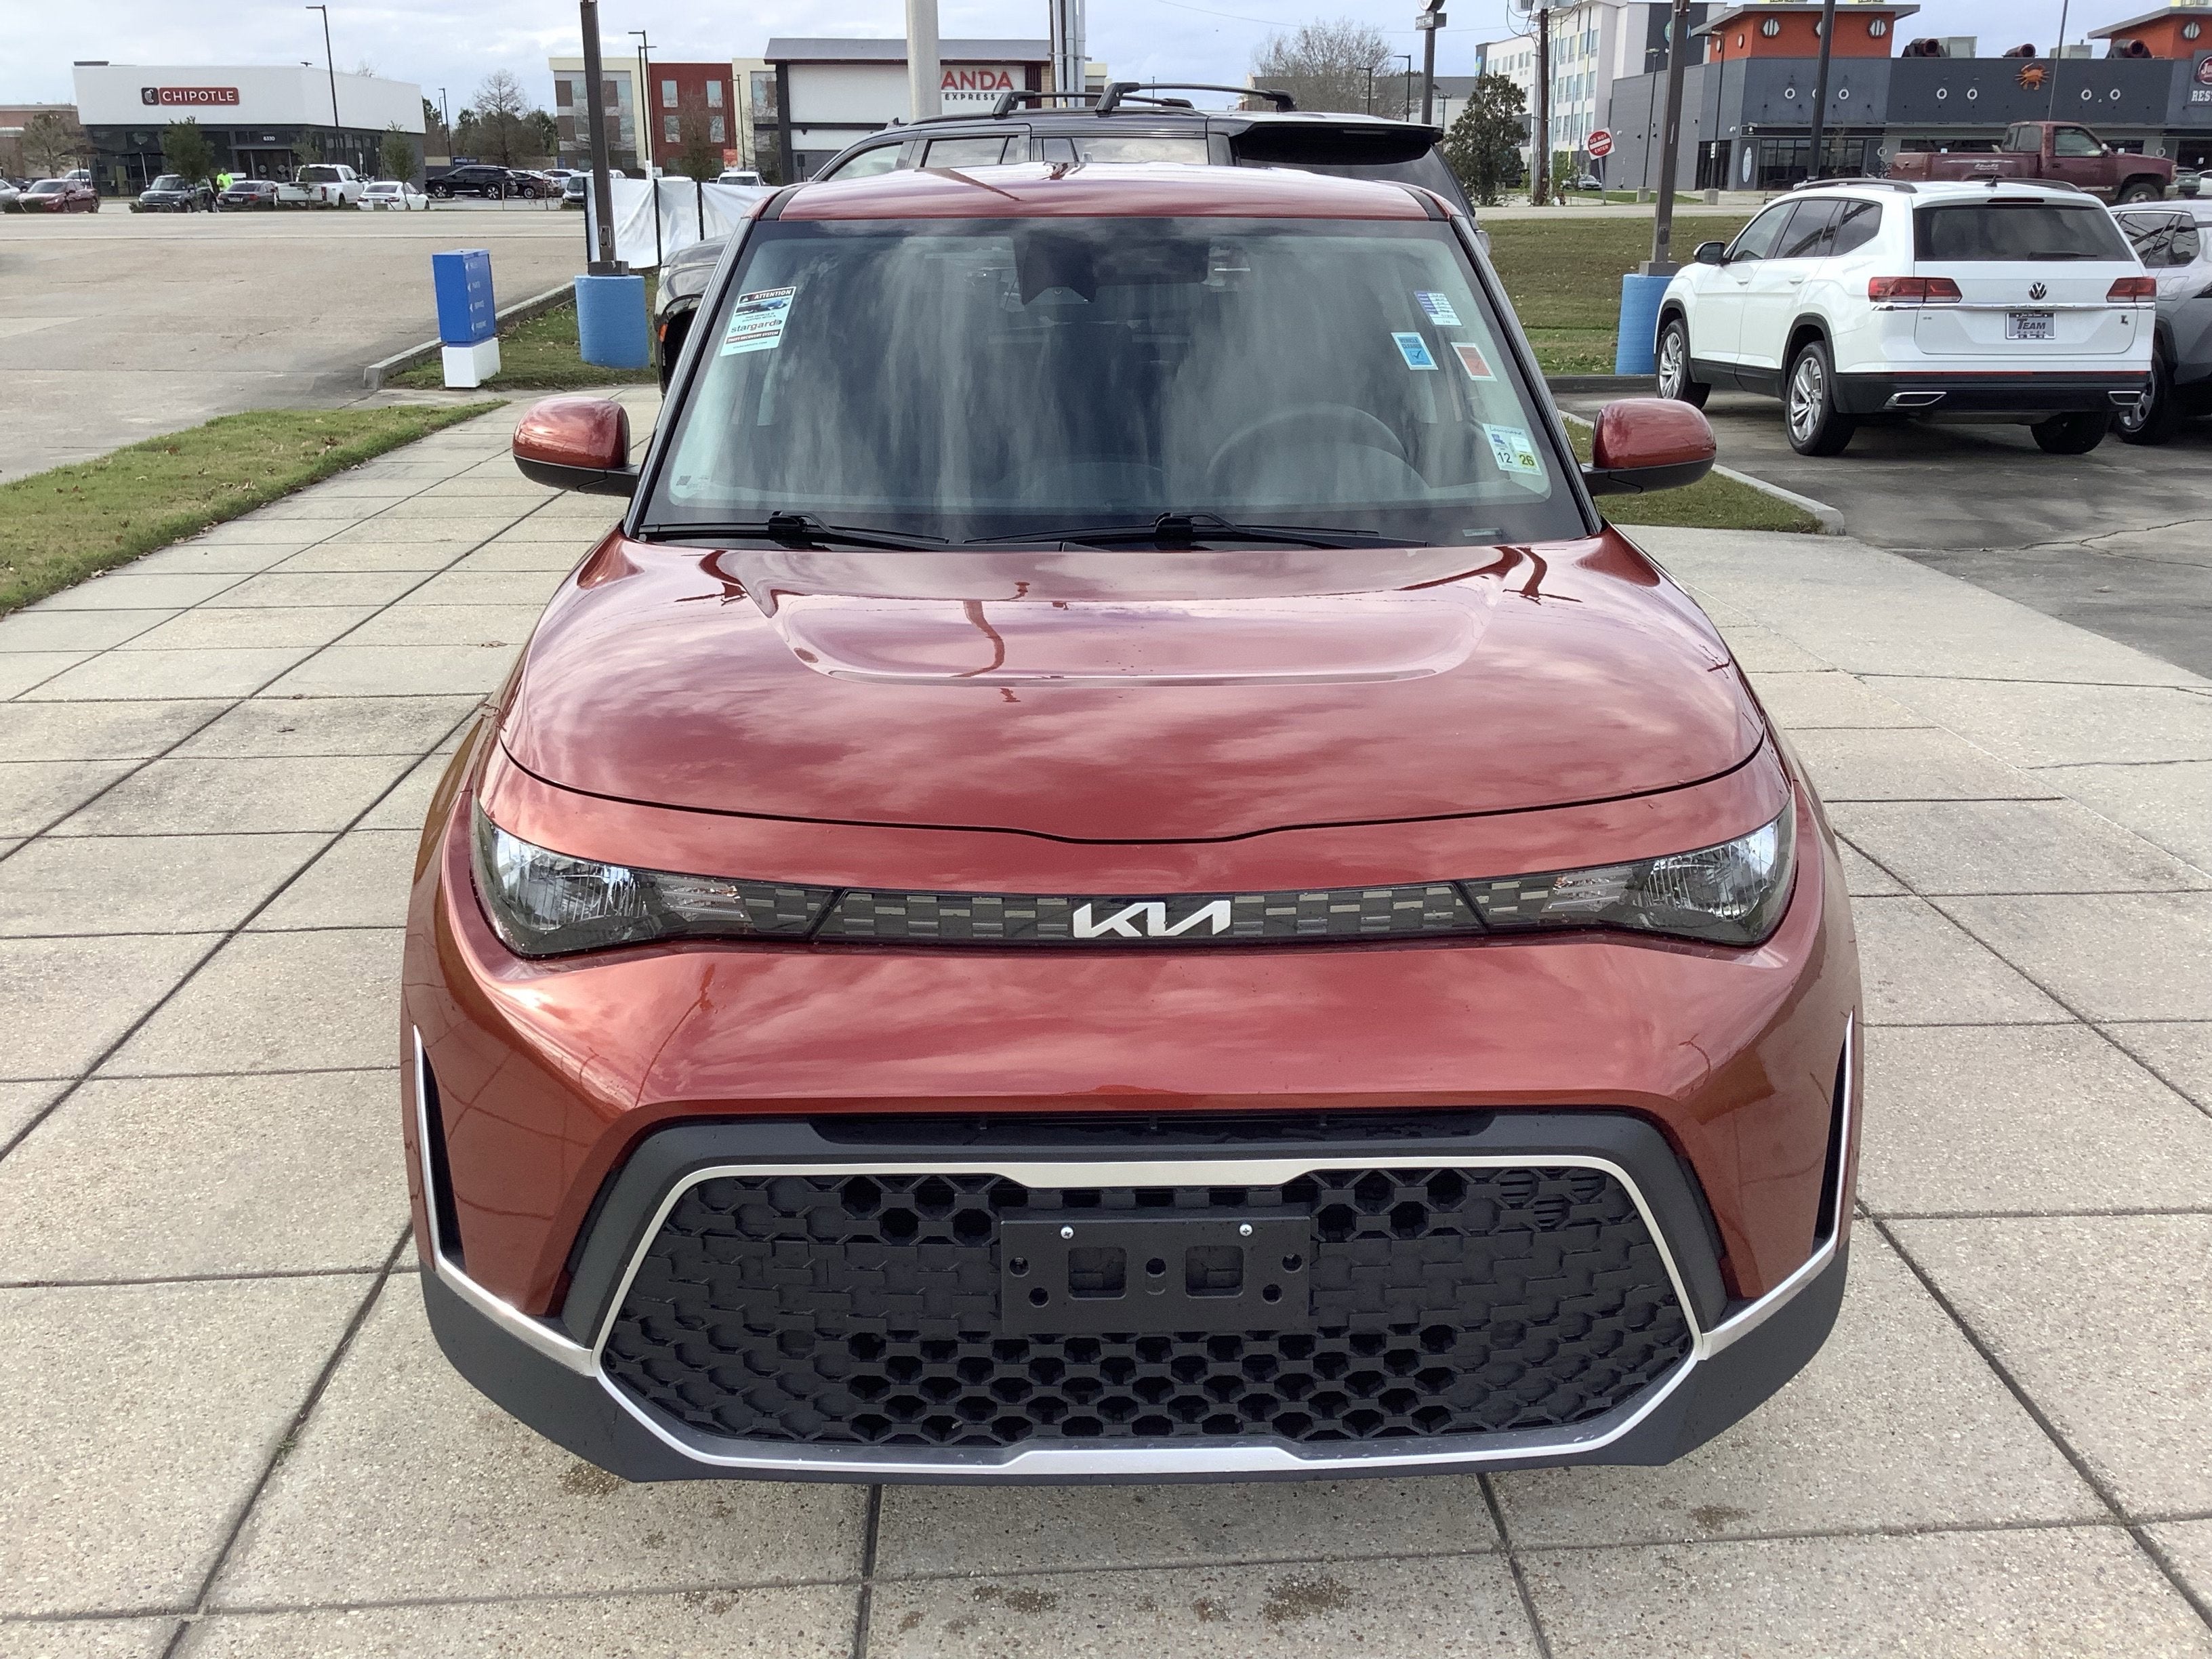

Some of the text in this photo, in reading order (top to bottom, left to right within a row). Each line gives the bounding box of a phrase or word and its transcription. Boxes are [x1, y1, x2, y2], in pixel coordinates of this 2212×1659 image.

[941, 70, 1014, 90] ANDA
[162, 91, 234, 102] CHIPOTLE
[2191, 90, 2212, 102] RES
[1594, 144, 1609, 154] ENTER
[754, 289, 792, 300] ATTENTION
[1497, 451, 1513, 464] 12
[1519, 454, 1534, 466] 26
